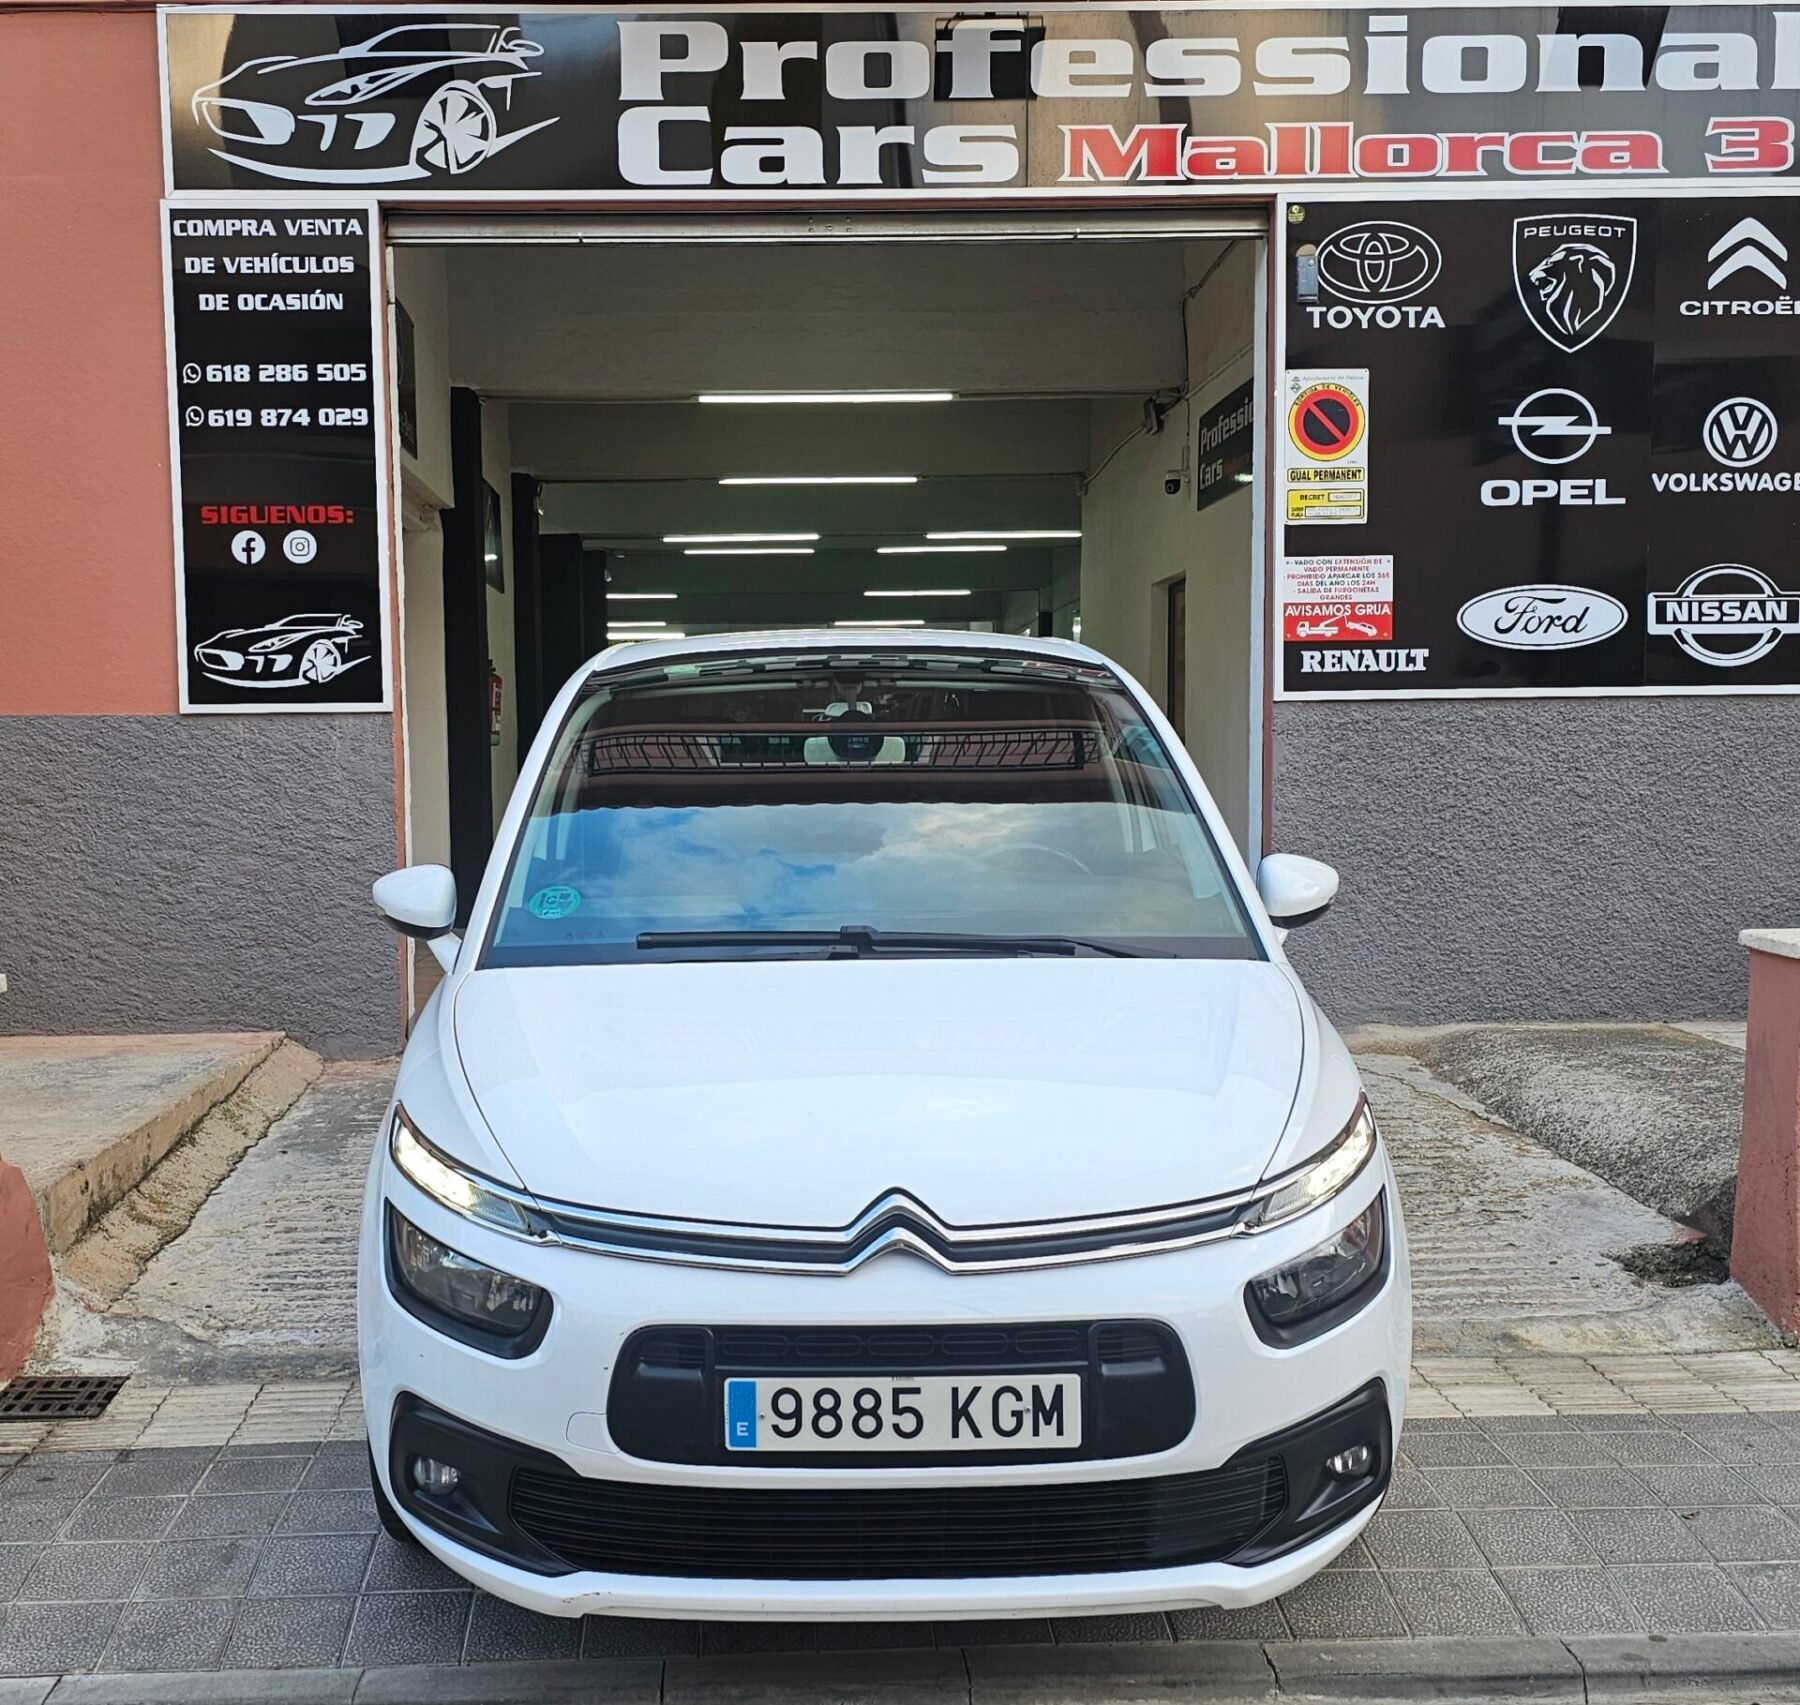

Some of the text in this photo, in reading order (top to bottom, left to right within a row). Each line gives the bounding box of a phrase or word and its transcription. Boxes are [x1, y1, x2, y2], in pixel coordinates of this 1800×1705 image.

[617, 12, 1800, 101] Professional
[618, 106, 1795, 185] Cars Mallorca 3
[173, 219, 364, 237] COMPRA VENTA
[1524, 225, 1626, 239] PEUGEOT
[184, 253, 355, 274] DE VEHÍCULOS
[198, 289, 344, 311] DE OCASIÓN
[1306, 305, 1446, 329] TOYOTA
[206, 363, 367, 382] 618 286 505
[208, 408, 369, 427] 619 874 029
[1200, 459, 1222, 490] Cars
[1290, 469, 1362, 481] GUAL PERMANENT
[1481, 479, 1626, 506] OPEL
[201, 505, 354, 524] SIGUENOS:
[1285, 604, 1391, 616] AVISAMOS GRUA
[1494, 596, 1590, 634] Ford
[1666, 600, 1788, 622] NISSAN
[1301, 649, 1429, 672] RENAULT
[771, 1384, 1064, 1439] 9885 KGM
[737, 1422, 749, 1436] E
